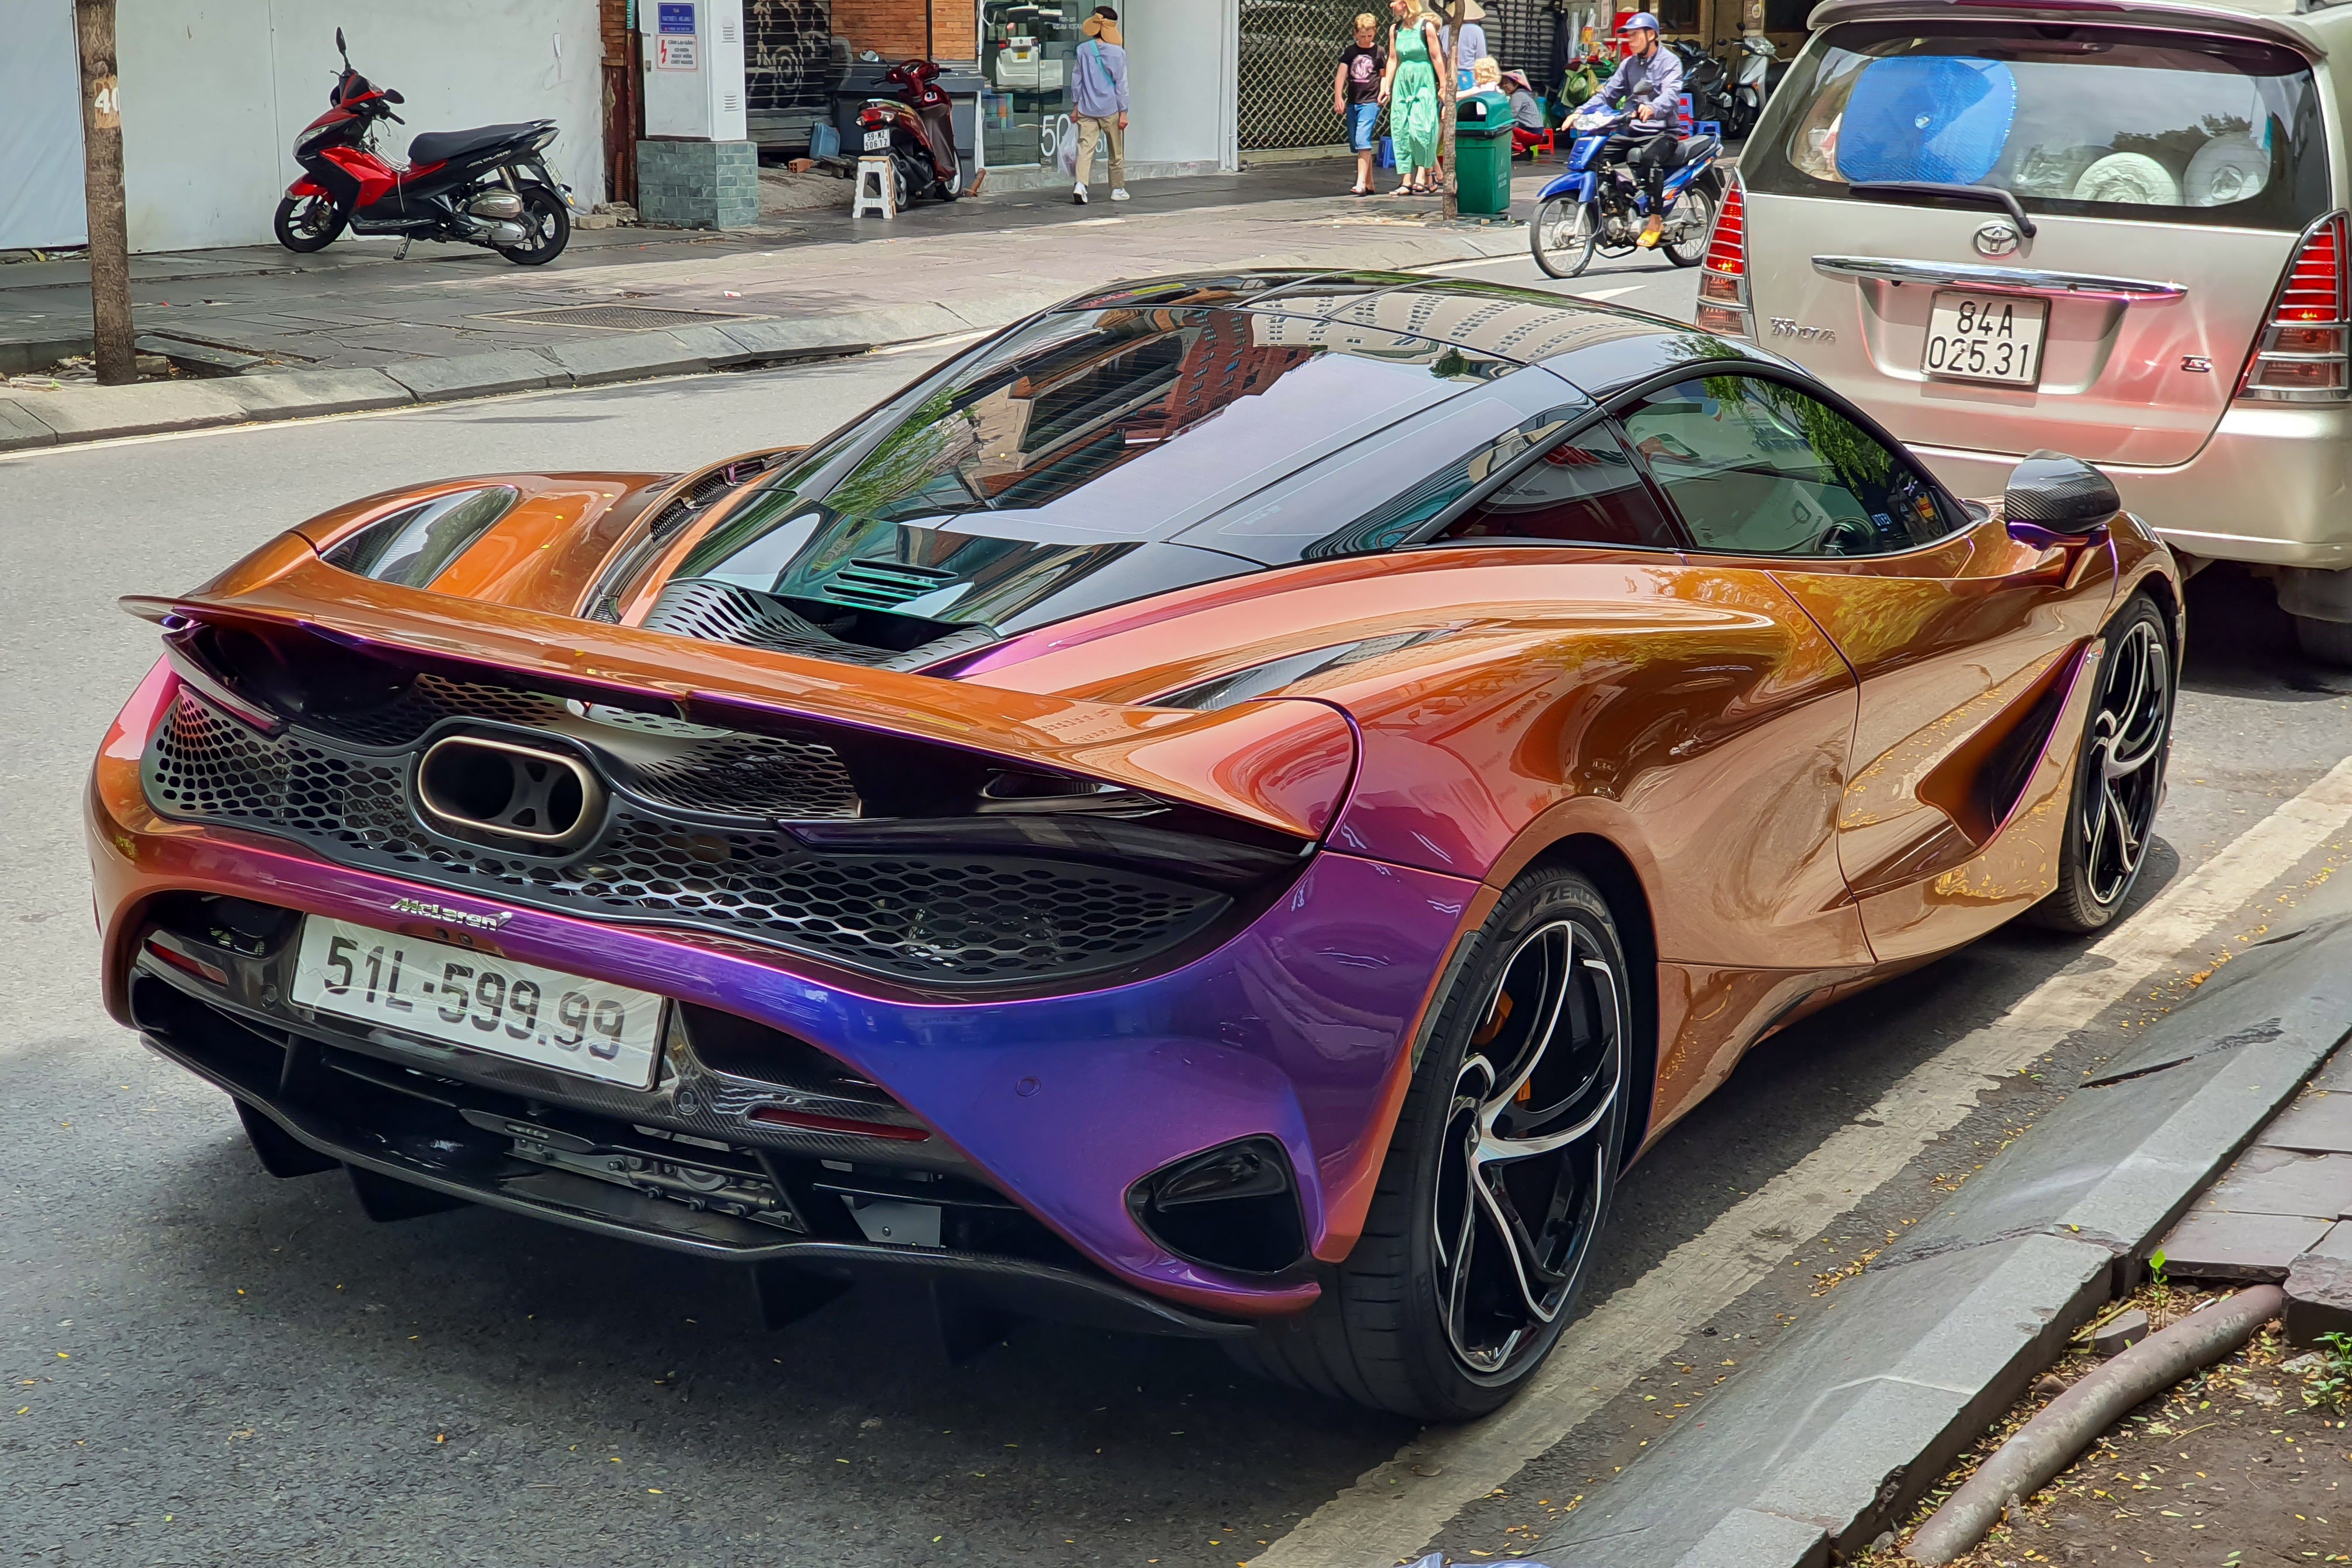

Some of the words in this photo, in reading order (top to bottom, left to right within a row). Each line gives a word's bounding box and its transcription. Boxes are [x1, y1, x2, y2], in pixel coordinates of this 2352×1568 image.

[1957, 300, 2013, 338] 84A
[1928, 336, 2029, 377] 025.31
[390, 898, 498, 931] McLaren
[324, 935, 625, 1060] 51L-599.99
